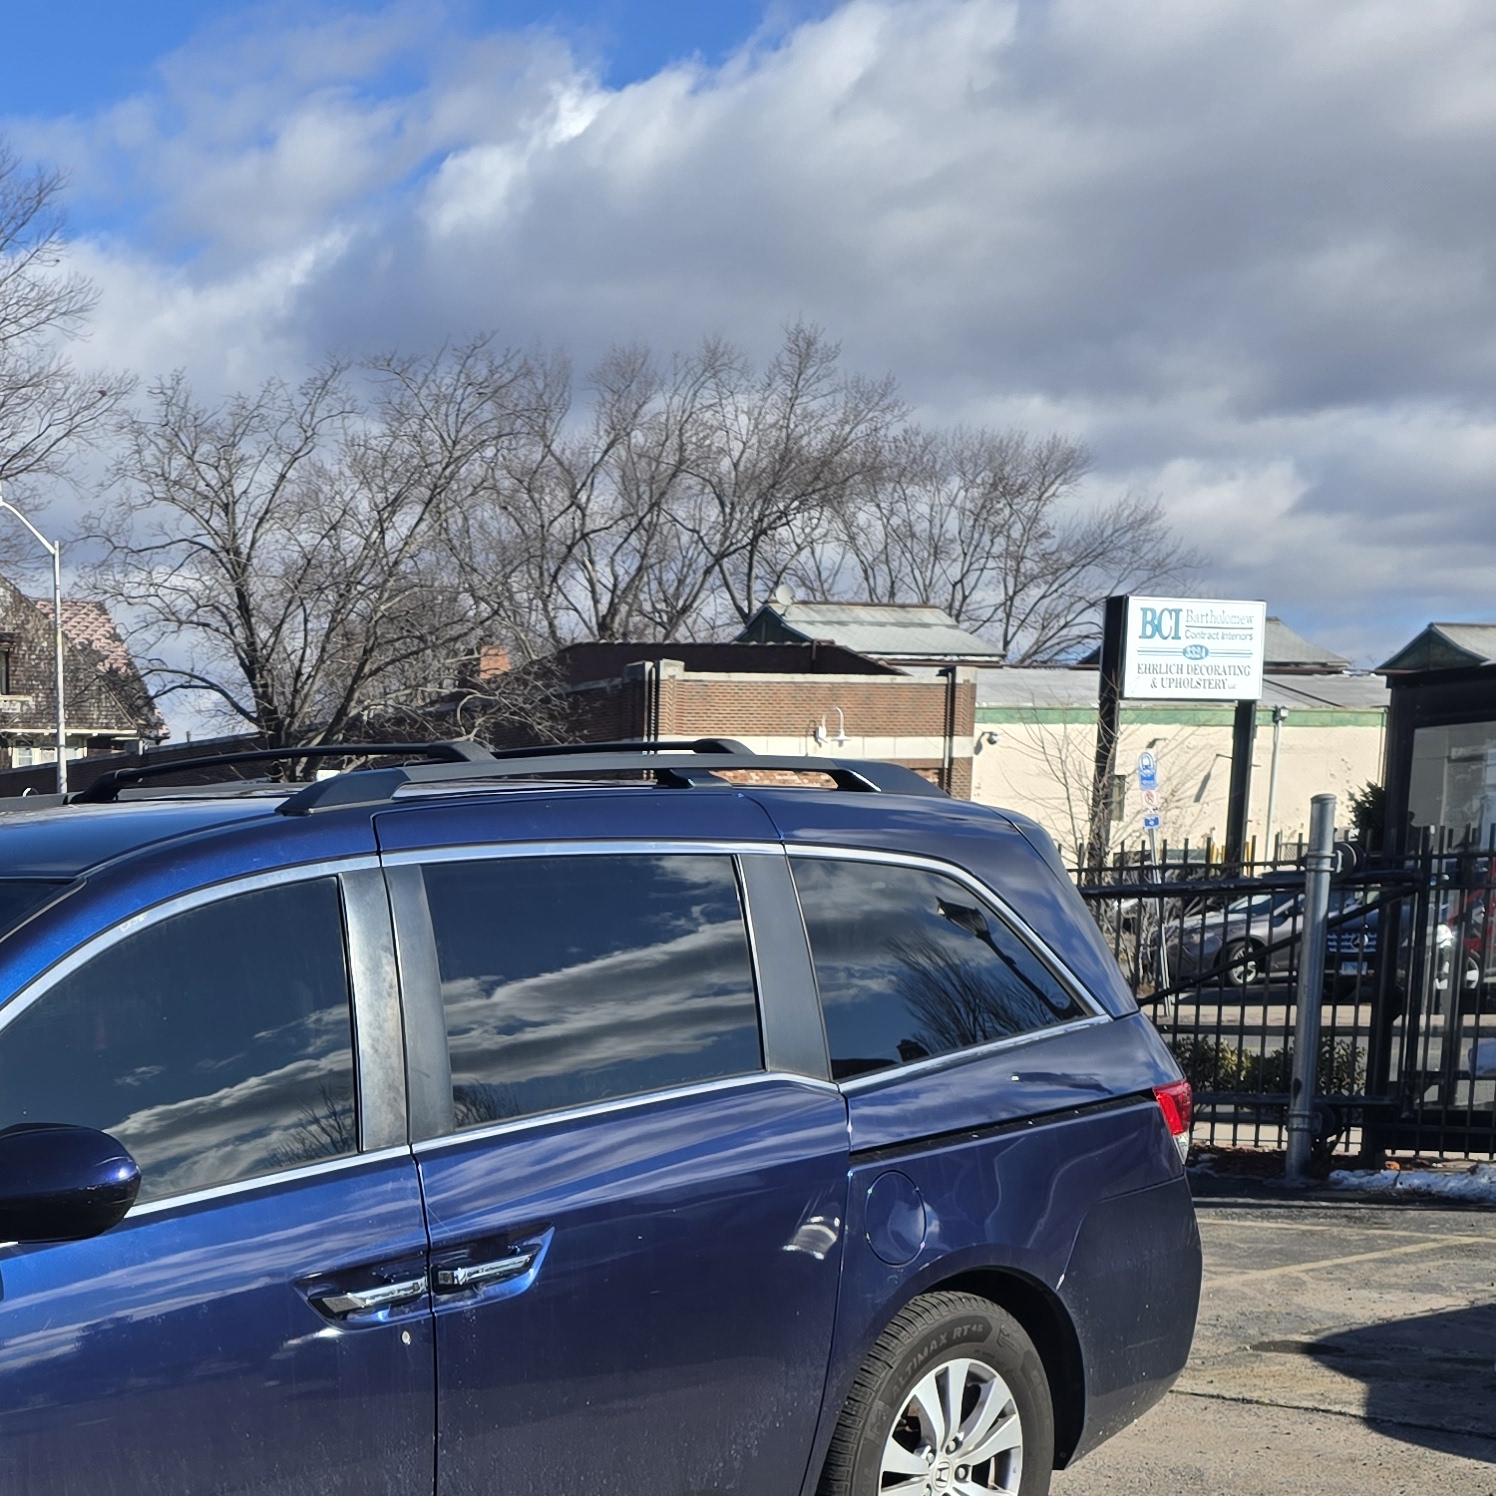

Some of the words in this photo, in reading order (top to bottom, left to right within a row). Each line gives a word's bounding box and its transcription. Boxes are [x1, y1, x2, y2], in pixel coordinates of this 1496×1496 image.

[1139, 607, 1183, 640] BCI
[1185, 609, 1254, 625] Bartholomew
[1185, 629, 1219, 640] Contract
[1221, 630, 1253, 641] Interiors
[1137, 663, 1183, 675] EHRLICH
[1186, 664, 1251, 677] DECORATING
[1150, 677, 1158, 689] &
[1160, 677, 1228, 690] UPHOLSTERY
